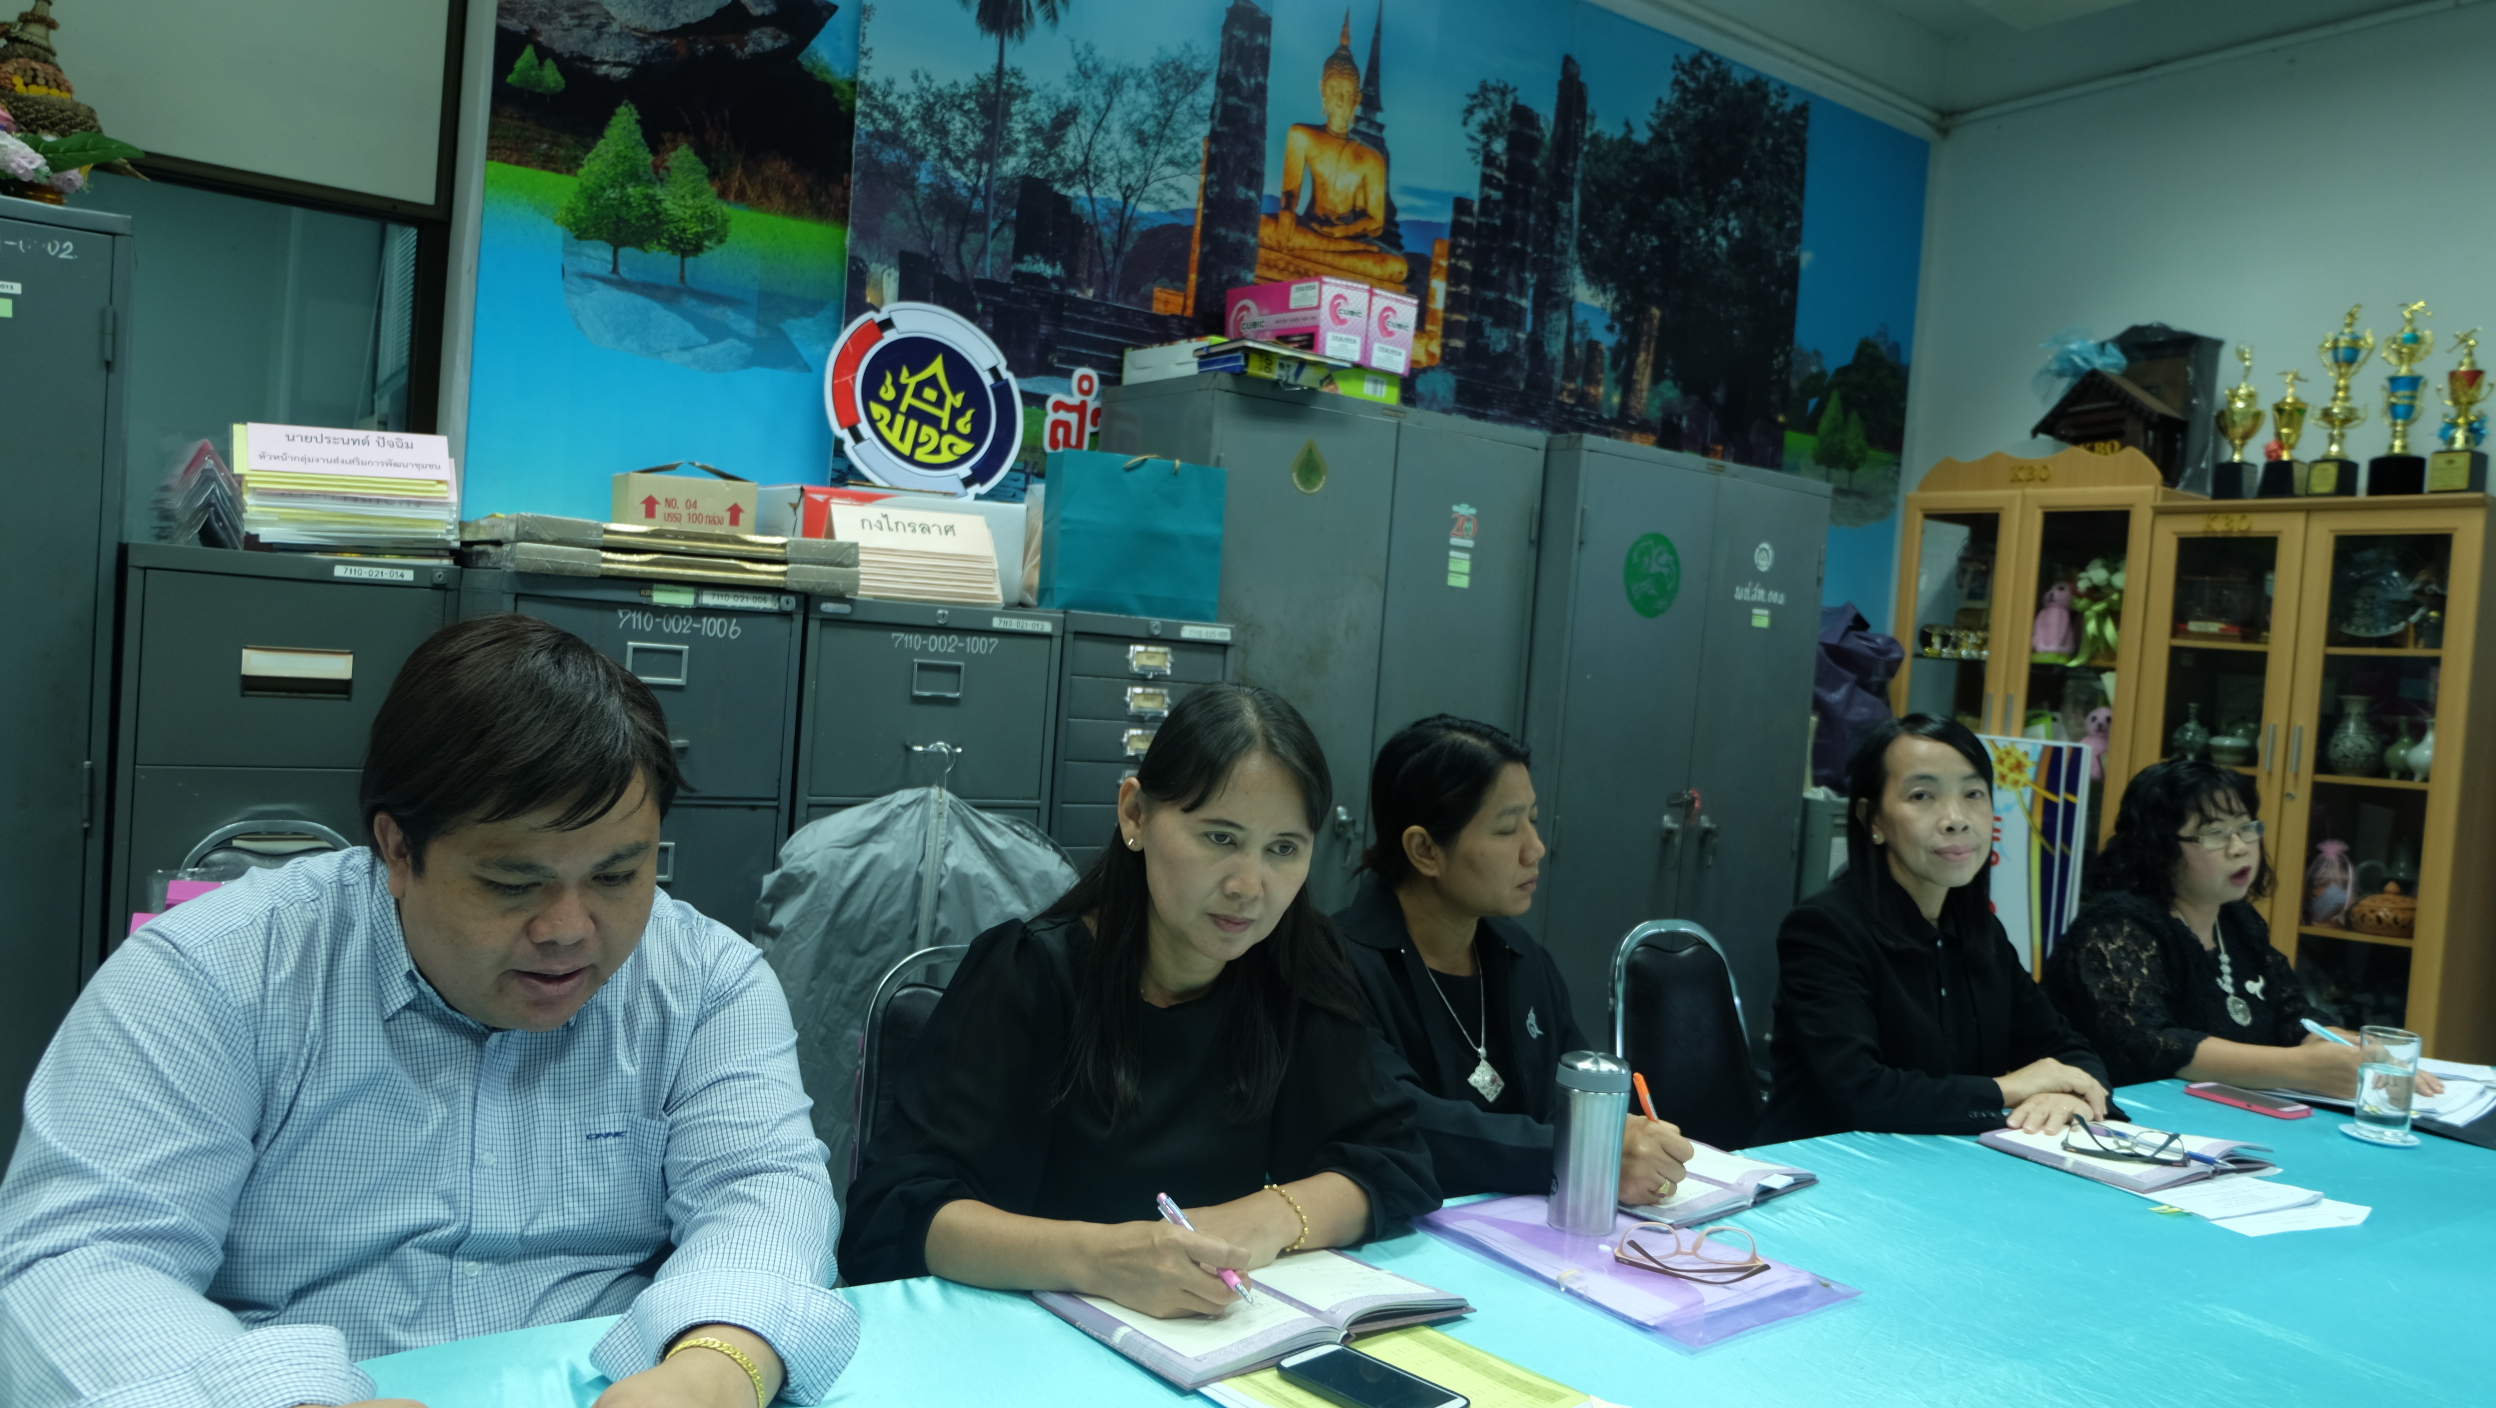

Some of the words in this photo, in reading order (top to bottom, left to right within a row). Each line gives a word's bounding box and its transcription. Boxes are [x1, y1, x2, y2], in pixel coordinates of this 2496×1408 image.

[1338, 308, 1363, 318] CUBIC
[1241, 320, 1266, 330] CUBIC
[1386, 320, 1410, 331] CUBIC
[376, 435, 414, 450] ปัจฉิม
[664, 497, 679, 509] NO.
[685, 499, 698, 510] 04
[664, 512, 682, 525] บรรจุ
[687, 512, 704, 525] 100
[705, 513, 724, 526] กล่อง
[860, 513, 956, 537] กงไกรลาศ
[343, 567, 405, 579] 7110-021-014
[618, 609, 742, 639] 7110-002-1006
[891, 632, 999, 655] 7110-002-1007
